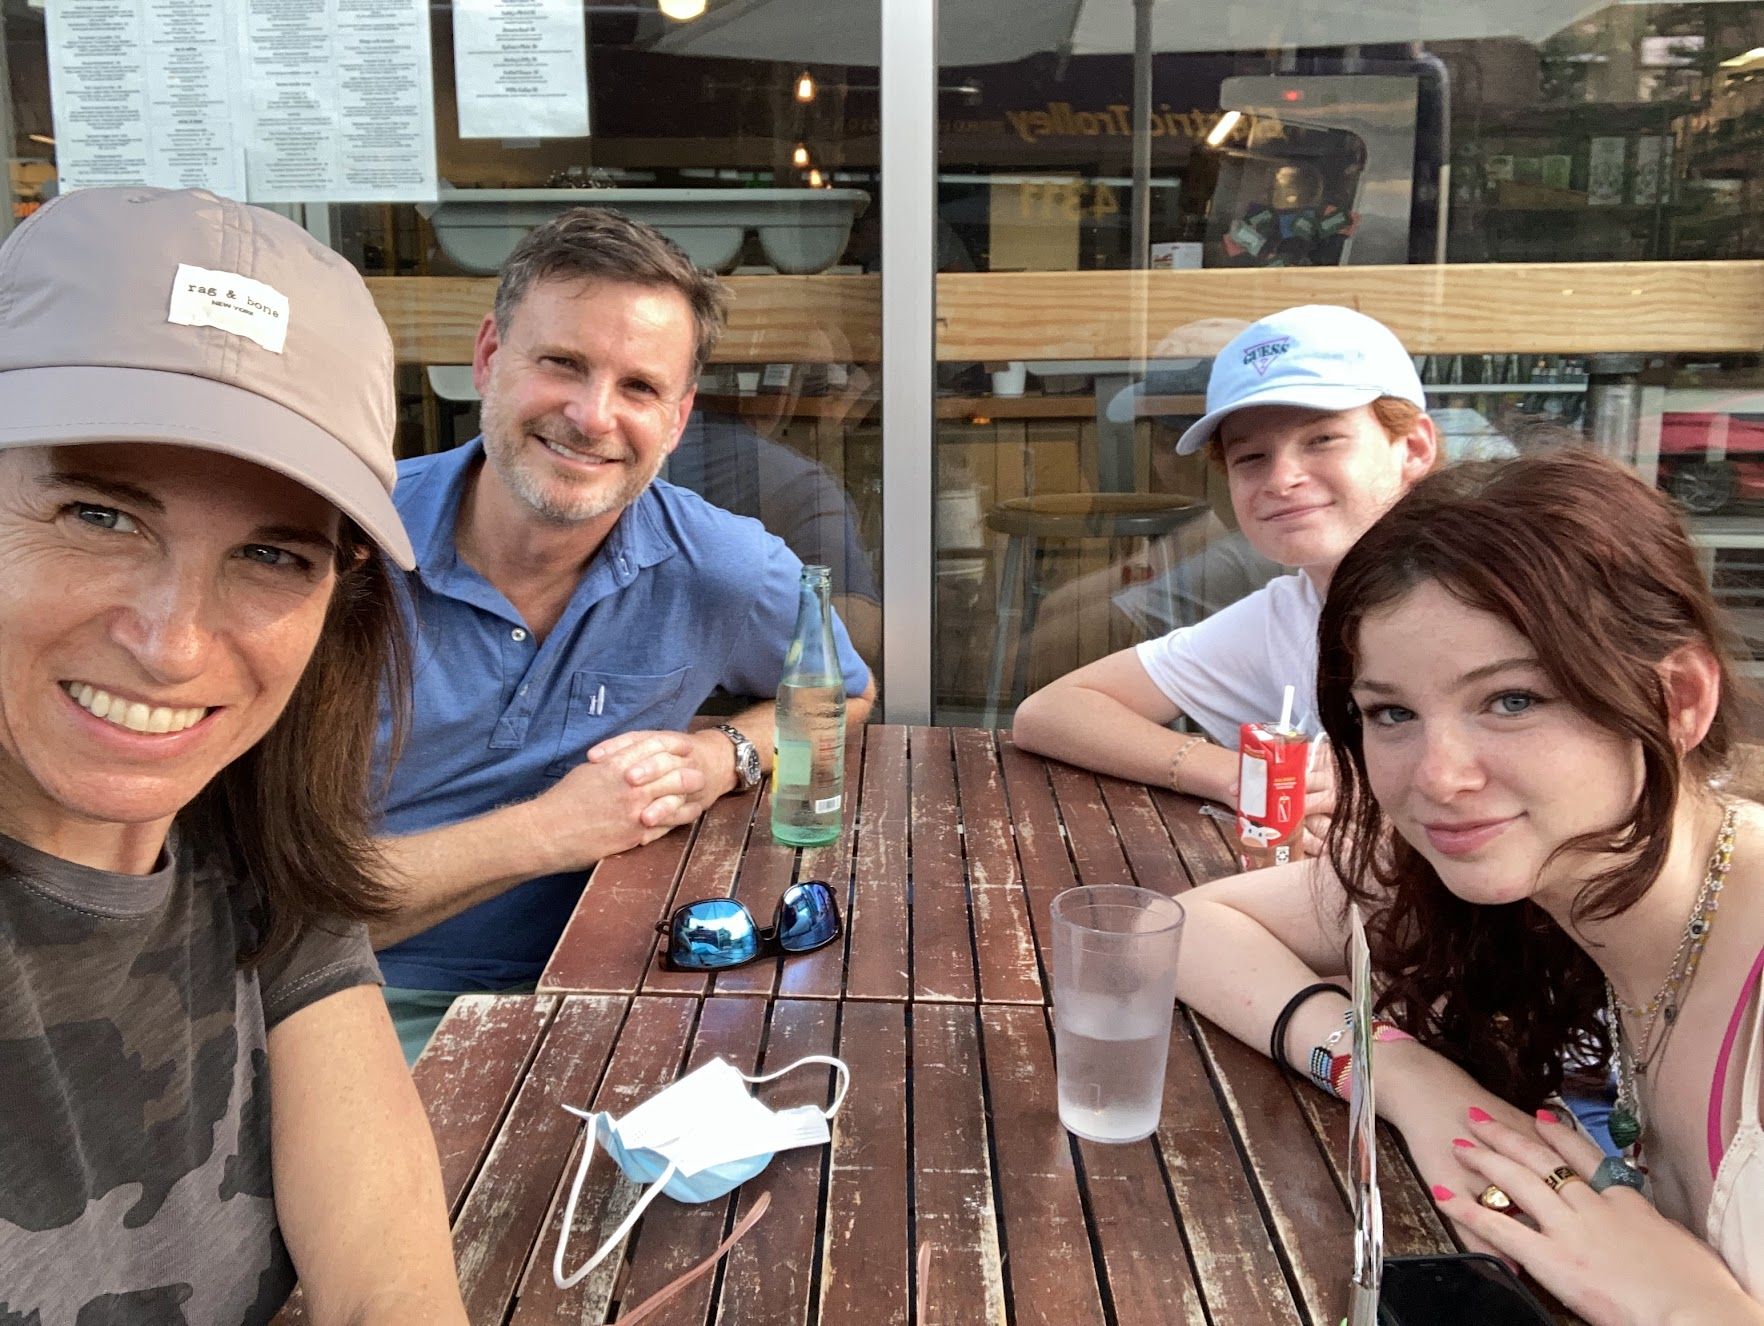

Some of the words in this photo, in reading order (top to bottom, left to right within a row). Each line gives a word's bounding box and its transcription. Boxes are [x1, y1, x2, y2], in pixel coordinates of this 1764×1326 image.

[188, 285, 217, 297] rag
[226, 290, 237, 299] &
[247, 296, 279, 317] bone
[211, 300, 231, 308] NEW
[233, 306, 254, 315] YORK
[1243, 343, 1290, 365] GUESS
